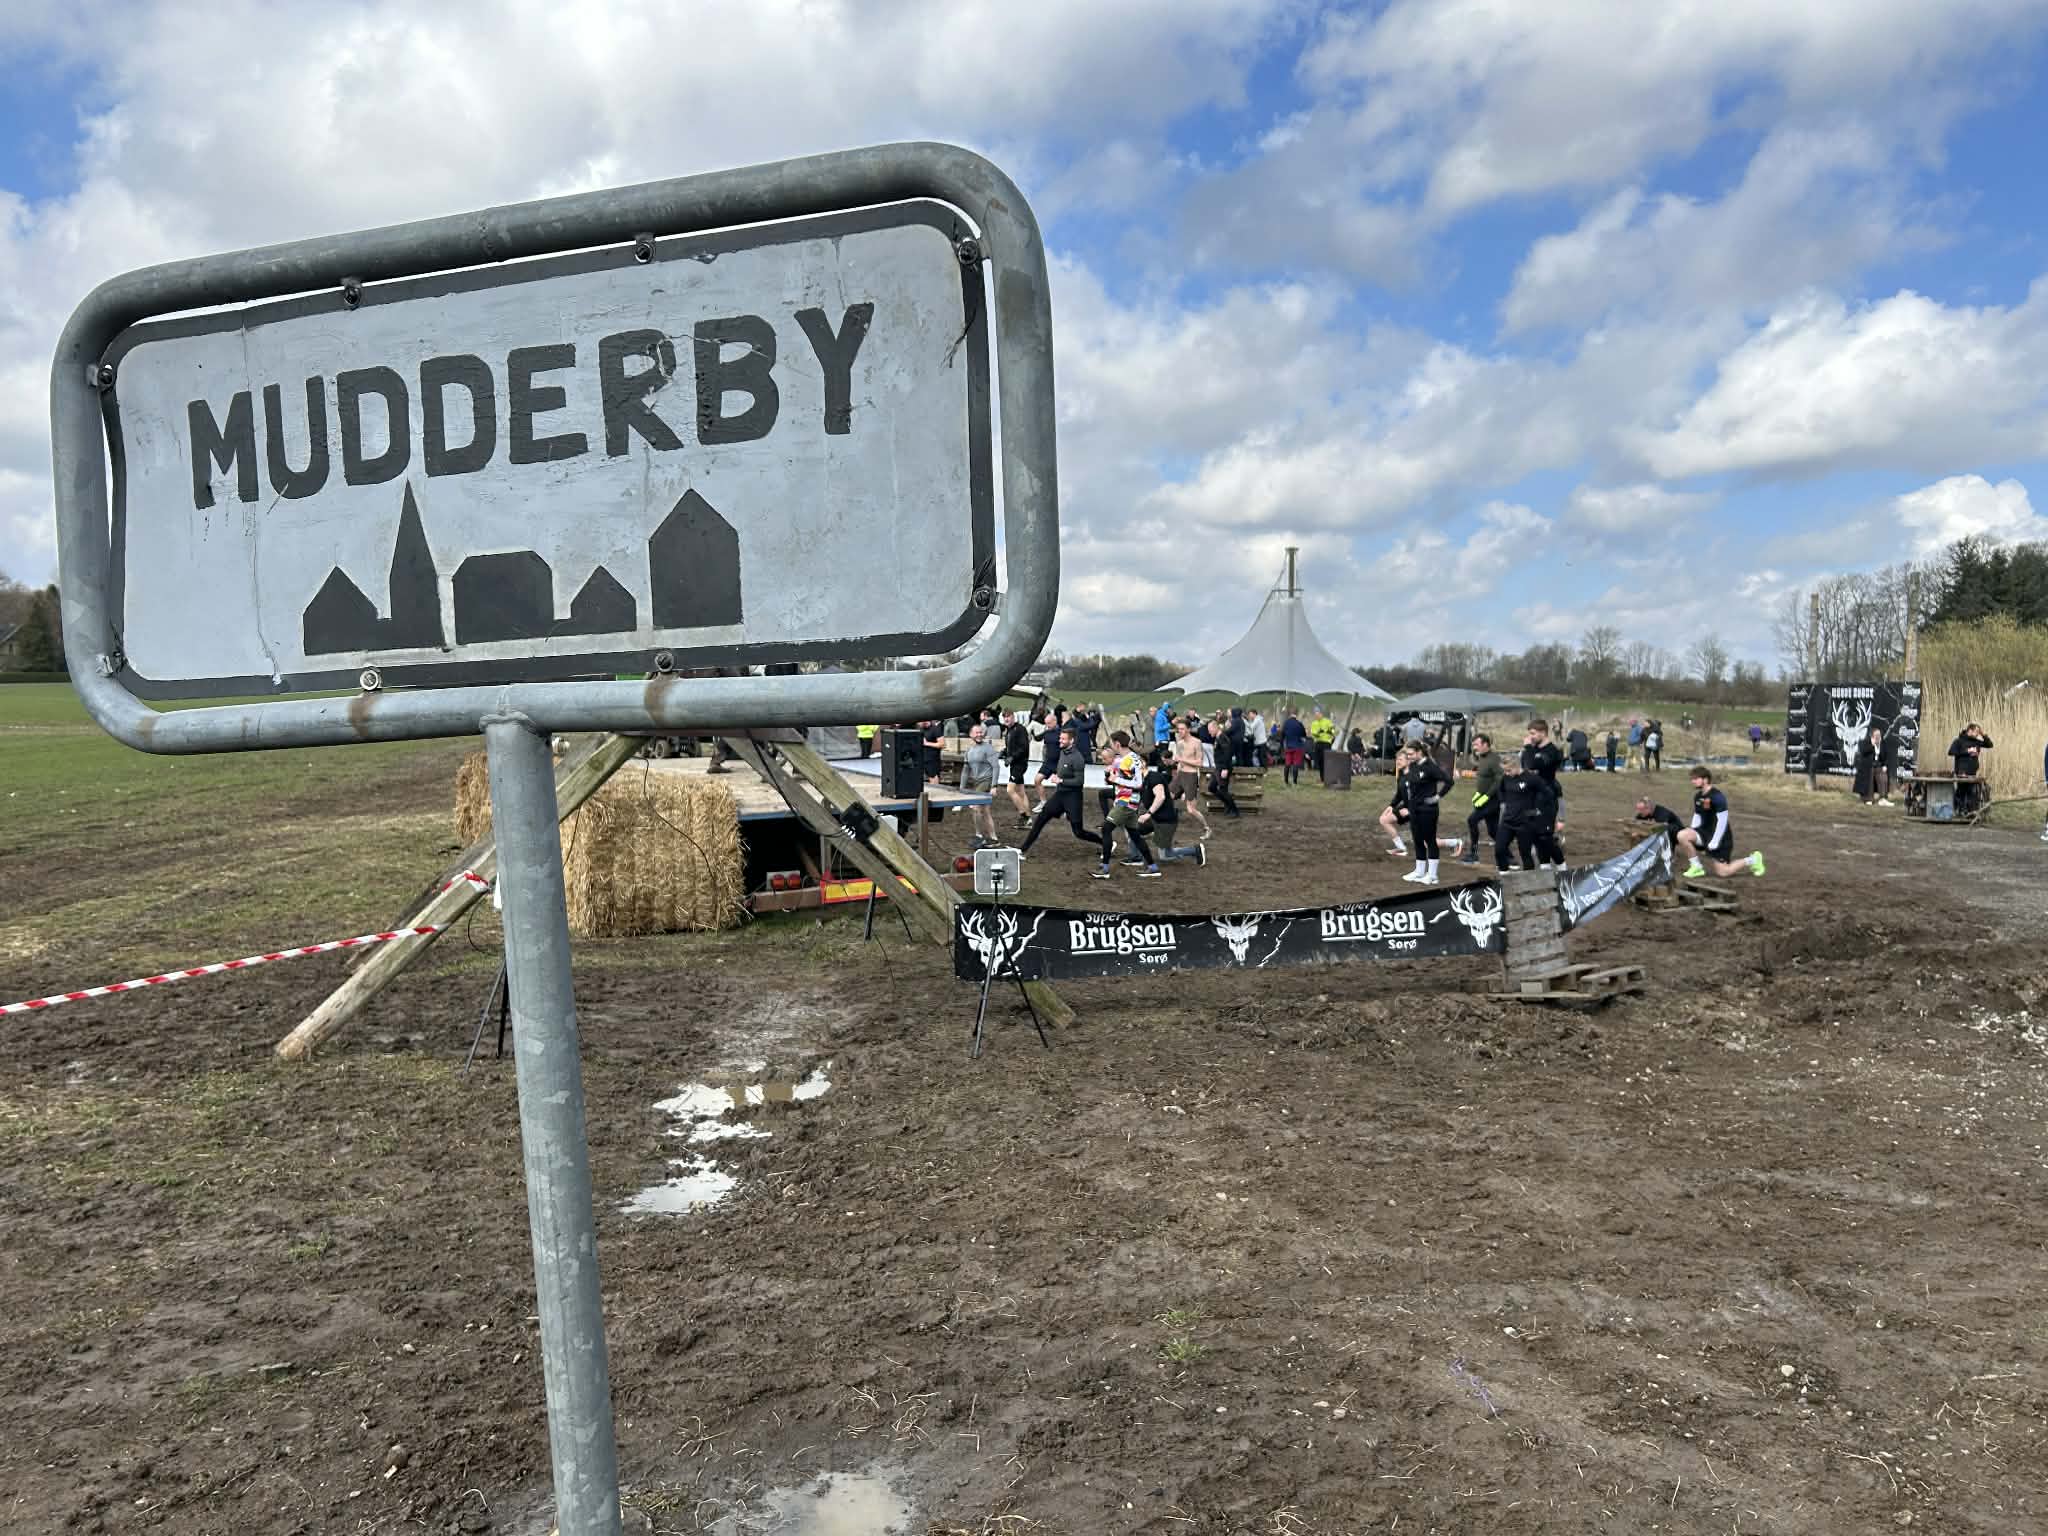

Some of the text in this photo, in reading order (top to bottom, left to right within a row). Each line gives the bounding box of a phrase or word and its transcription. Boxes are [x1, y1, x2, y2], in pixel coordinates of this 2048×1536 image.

[188, 302, 874, 510] MUDDERBY
[1069, 919, 1176, 955] Brugsen
[1320, 907, 1425, 940] Brugsen
[1138, 953, 1168, 963] Sorø
[1388, 939, 1417, 950] Sorø
